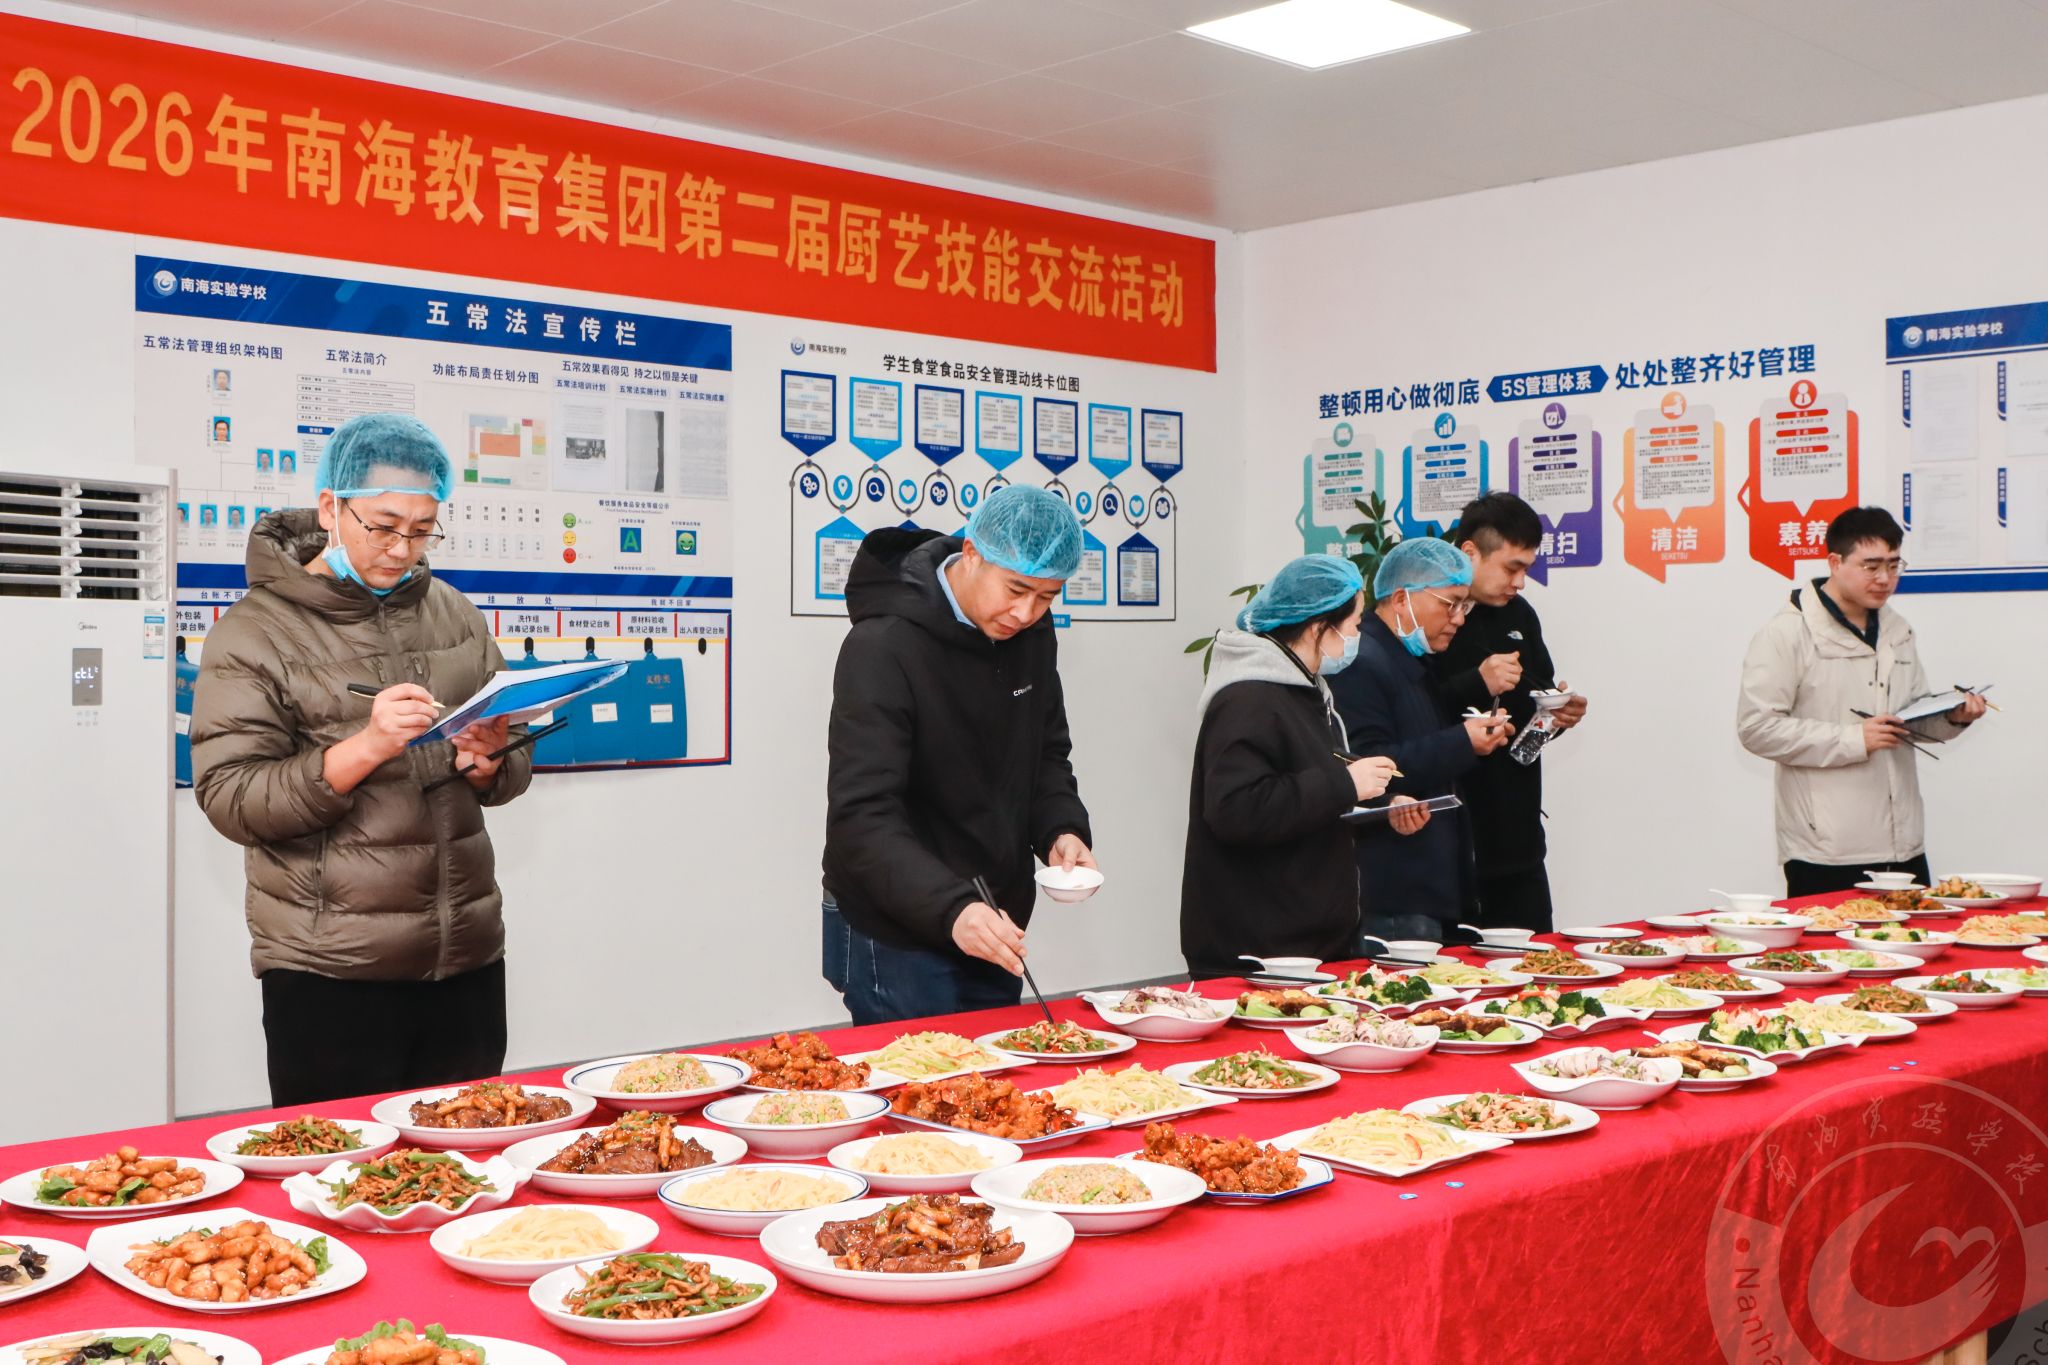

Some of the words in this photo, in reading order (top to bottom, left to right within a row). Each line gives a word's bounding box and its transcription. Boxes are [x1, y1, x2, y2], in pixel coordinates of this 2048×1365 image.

[10, 65, 1185, 329] 2026年南海教育集团第二届厨艺技能交流活动
[180, 277, 267, 301] 南海实验学校
[426, 300, 637, 347] 五常法宣传栏
[1926, 322, 2004, 342] 南海实验学校
[143, 335, 283, 360] 五常法管理组织架构图
[325, 349, 388, 366] 五常法简介
[808, 343, 847, 356] 南海实验学校
[432, 363, 539, 384] 功能布局责任划分图
[561, 360, 629, 378] 五常效果看得见
[634, 368, 699, 384] 持之以恒是关键
[883, 353, 1080, 393] 学生食堂食品安全管理动线卡位图
[1615, 344, 1817, 391] 处处整齐好管理
[556, 379, 607, 392] 五常法培训计划
[619, 385, 668, 398] 五常法实施计划
[1501, 370, 1592, 398] 5S管理体系
[679, 390, 725, 402] 五常法实施成果
[1318, 379, 1480, 420] 整顿用心做彻底
[1651, 526, 1698, 552] 清洁
[1778, 519, 1829, 547] 素养
[487, 595, 553, 605] 挂放处
[507, 625, 551, 634] 消毒记录台账
[568, 619, 611, 629] 食材登记台账
[630, 615, 665, 625] 原材料验收
[627, 626, 668, 635] 情况记录台账
[679, 626, 725, 635] 出入库登记台账
